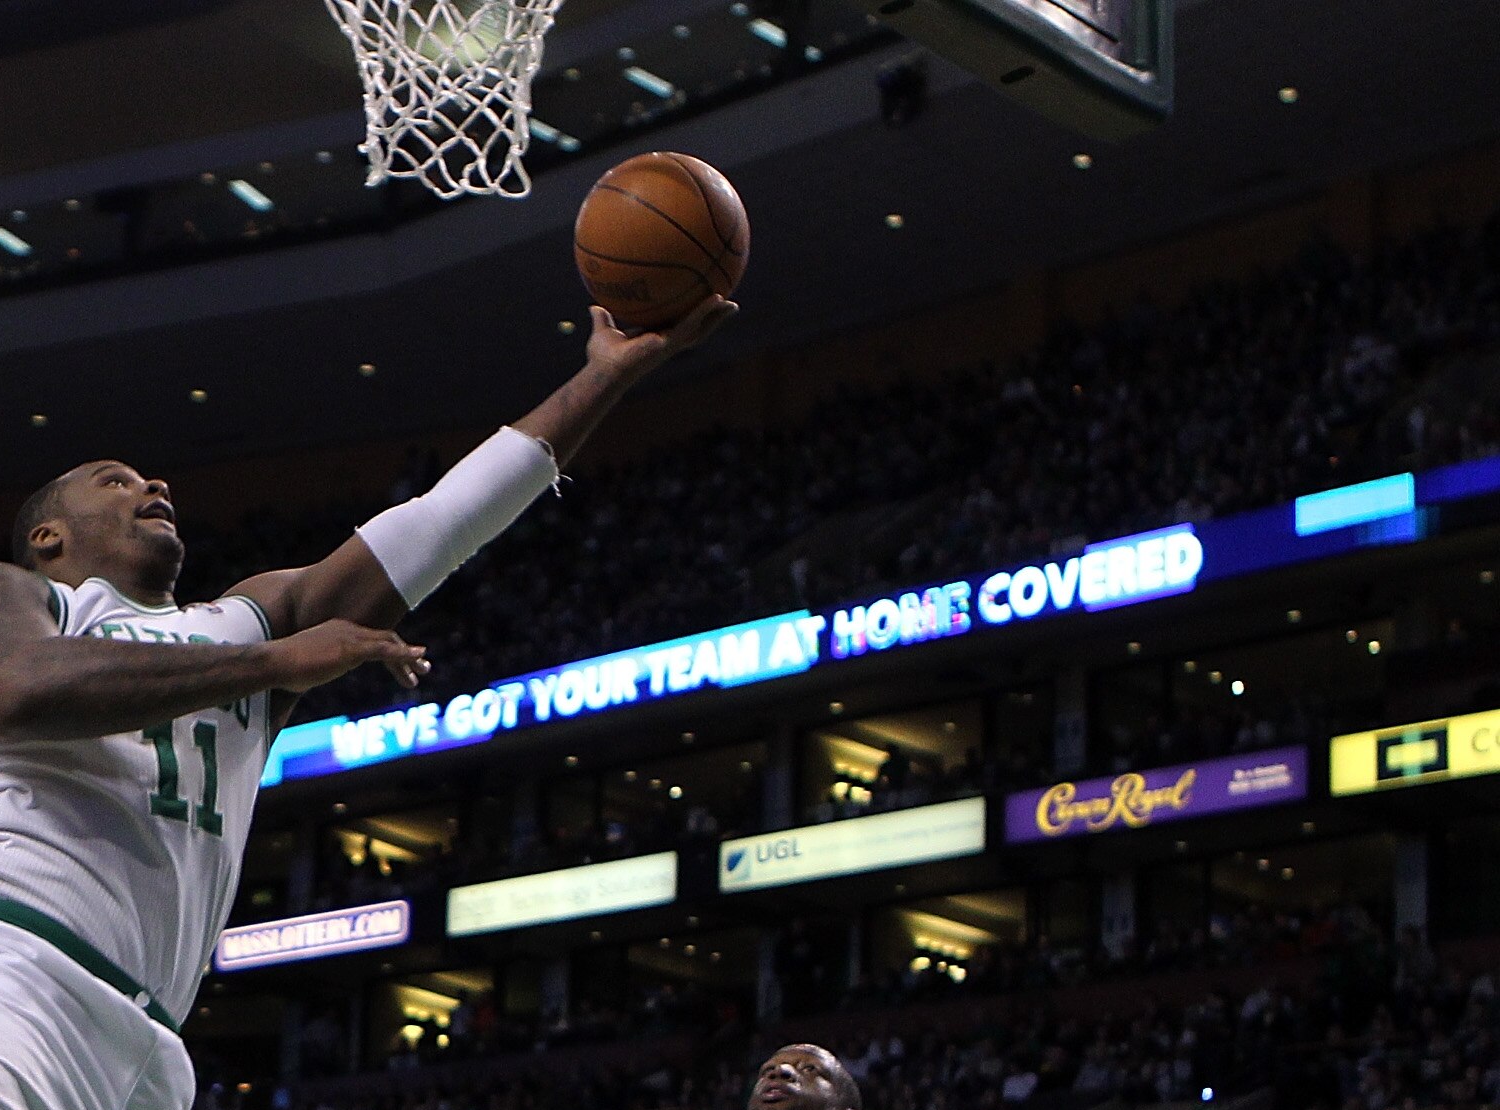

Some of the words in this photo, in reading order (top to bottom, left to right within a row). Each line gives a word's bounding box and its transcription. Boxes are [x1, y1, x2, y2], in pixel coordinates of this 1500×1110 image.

[331, 701, 440, 762] WE'VE
[443, 682, 526, 738] GOT
[528, 656, 639, 722] YOUR
[642, 628, 760, 696] TEAM
[766, 613, 825, 669] AT
[830, 580, 972, 659] HOME
[978, 531, 1203, 624] COVERED
[143, 717, 224, 837] 11
[756, 838, 803, 864] UGL
